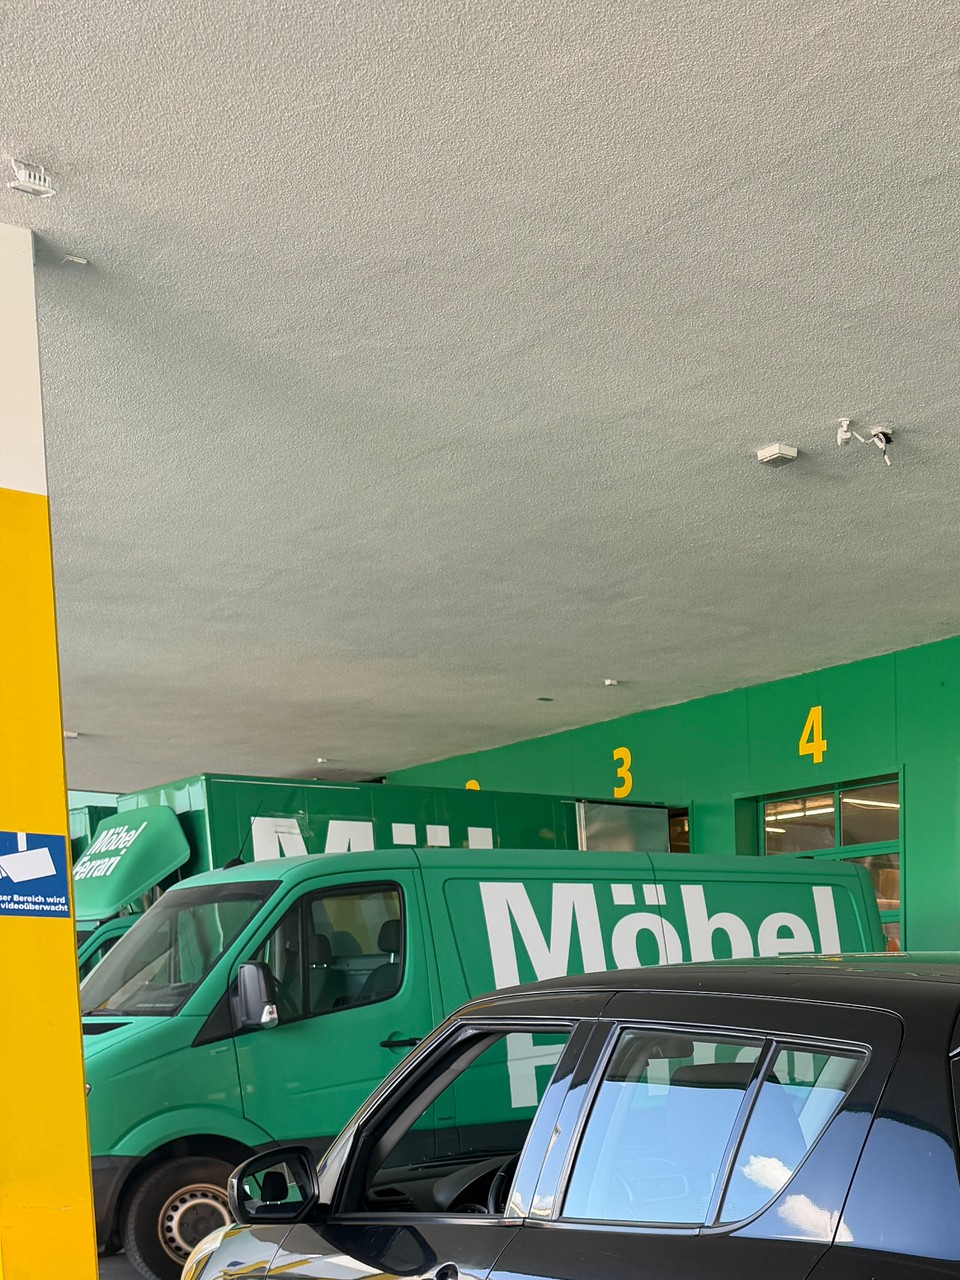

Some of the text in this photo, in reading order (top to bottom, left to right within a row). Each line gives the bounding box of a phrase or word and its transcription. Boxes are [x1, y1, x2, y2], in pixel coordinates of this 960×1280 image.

[798, 705, 828, 764] 4
[612, 747, 633, 799] 3
[86, 821, 148, 855] Möbel
[1, 902, 69, 912] videoüberwacht
[13, 894, 45, 903] Bereich
[46, 896, 66, 904] wird
[478, 880, 842, 990] Möbel
